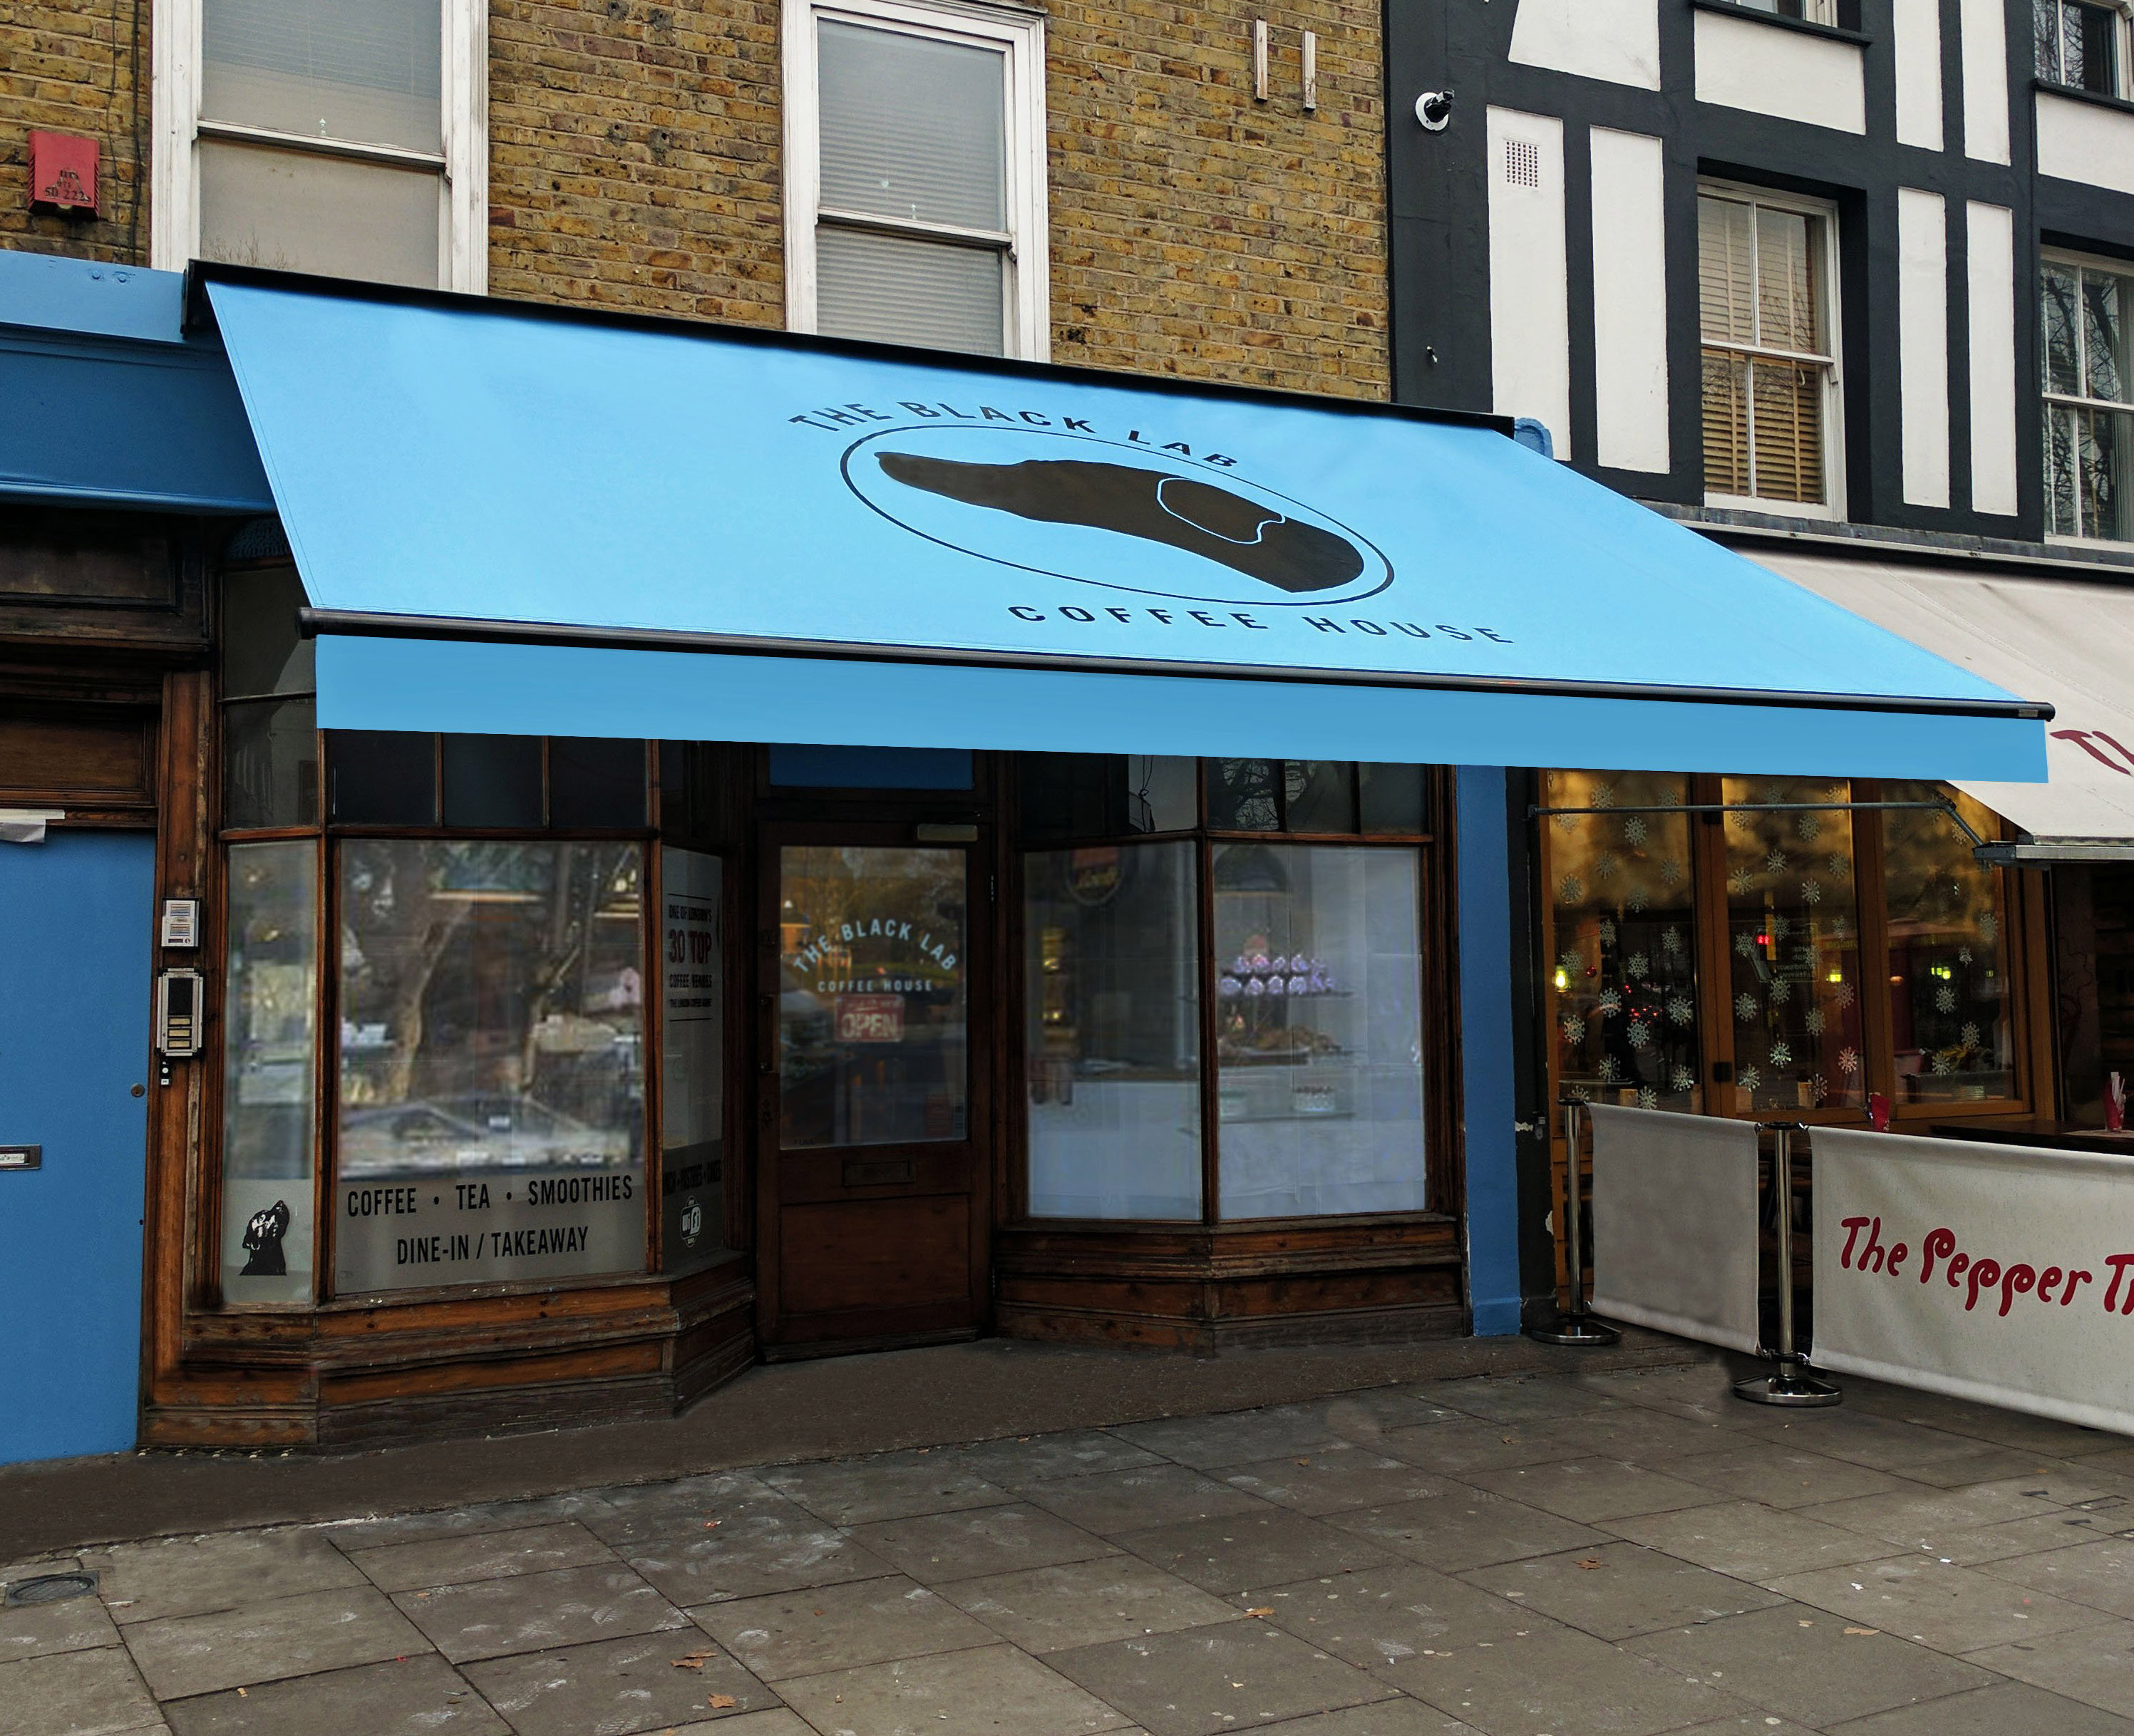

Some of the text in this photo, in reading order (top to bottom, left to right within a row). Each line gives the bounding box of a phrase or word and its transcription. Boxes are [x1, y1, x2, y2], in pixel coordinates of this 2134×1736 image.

[787, 401, 1239, 467] THE BLACK LAB
[1006, 605, 1515, 644] COFFEE HOUSE
[2050, 729, 2134, 775] T
[669, 929, 712, 963] 30 TOP
[793, 917, 958, 973] THE BLACK LAB
[669, 973, 689, 988] COFFEE
[817, 978, 932, 993] COFFEE HOUSE
[840, 1012, 899, 1039] OPEN
[346, 1187, 418, 1218] COFFEE
[454, 1183, 492, 1211] TEA
[527, 1174, 634, 1207] SMOOTHIES
[396, 1234, 470, 1265] DINE-IN
[490, 1225, 589, 1259] TAKEAWAY
[1840, 1216, 1909, 1276] The
[1919, 1227, 2093, 1318] Pepper
